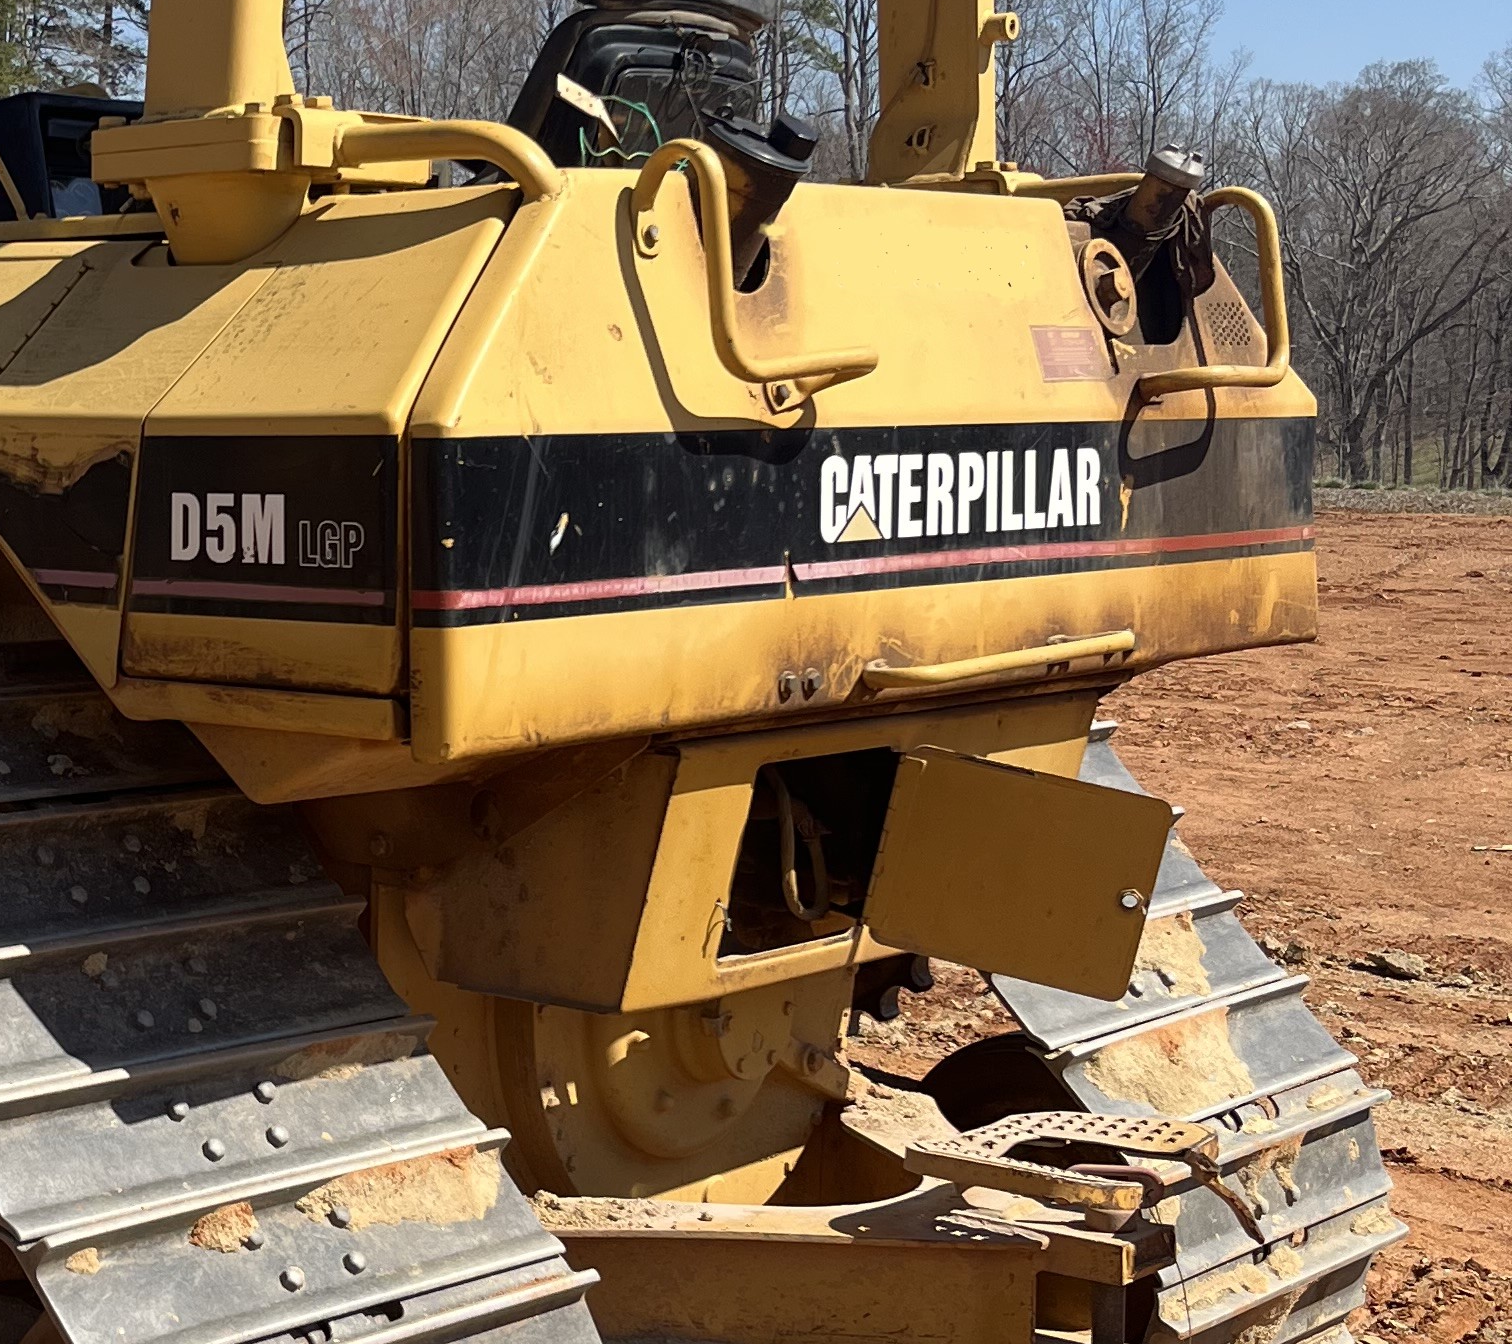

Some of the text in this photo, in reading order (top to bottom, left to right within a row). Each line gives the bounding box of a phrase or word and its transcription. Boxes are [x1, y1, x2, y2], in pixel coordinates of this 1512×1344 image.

[171, 492, 365, 568] D5M LGP
[820, 448, 1101, 544] CATERPILLAR
